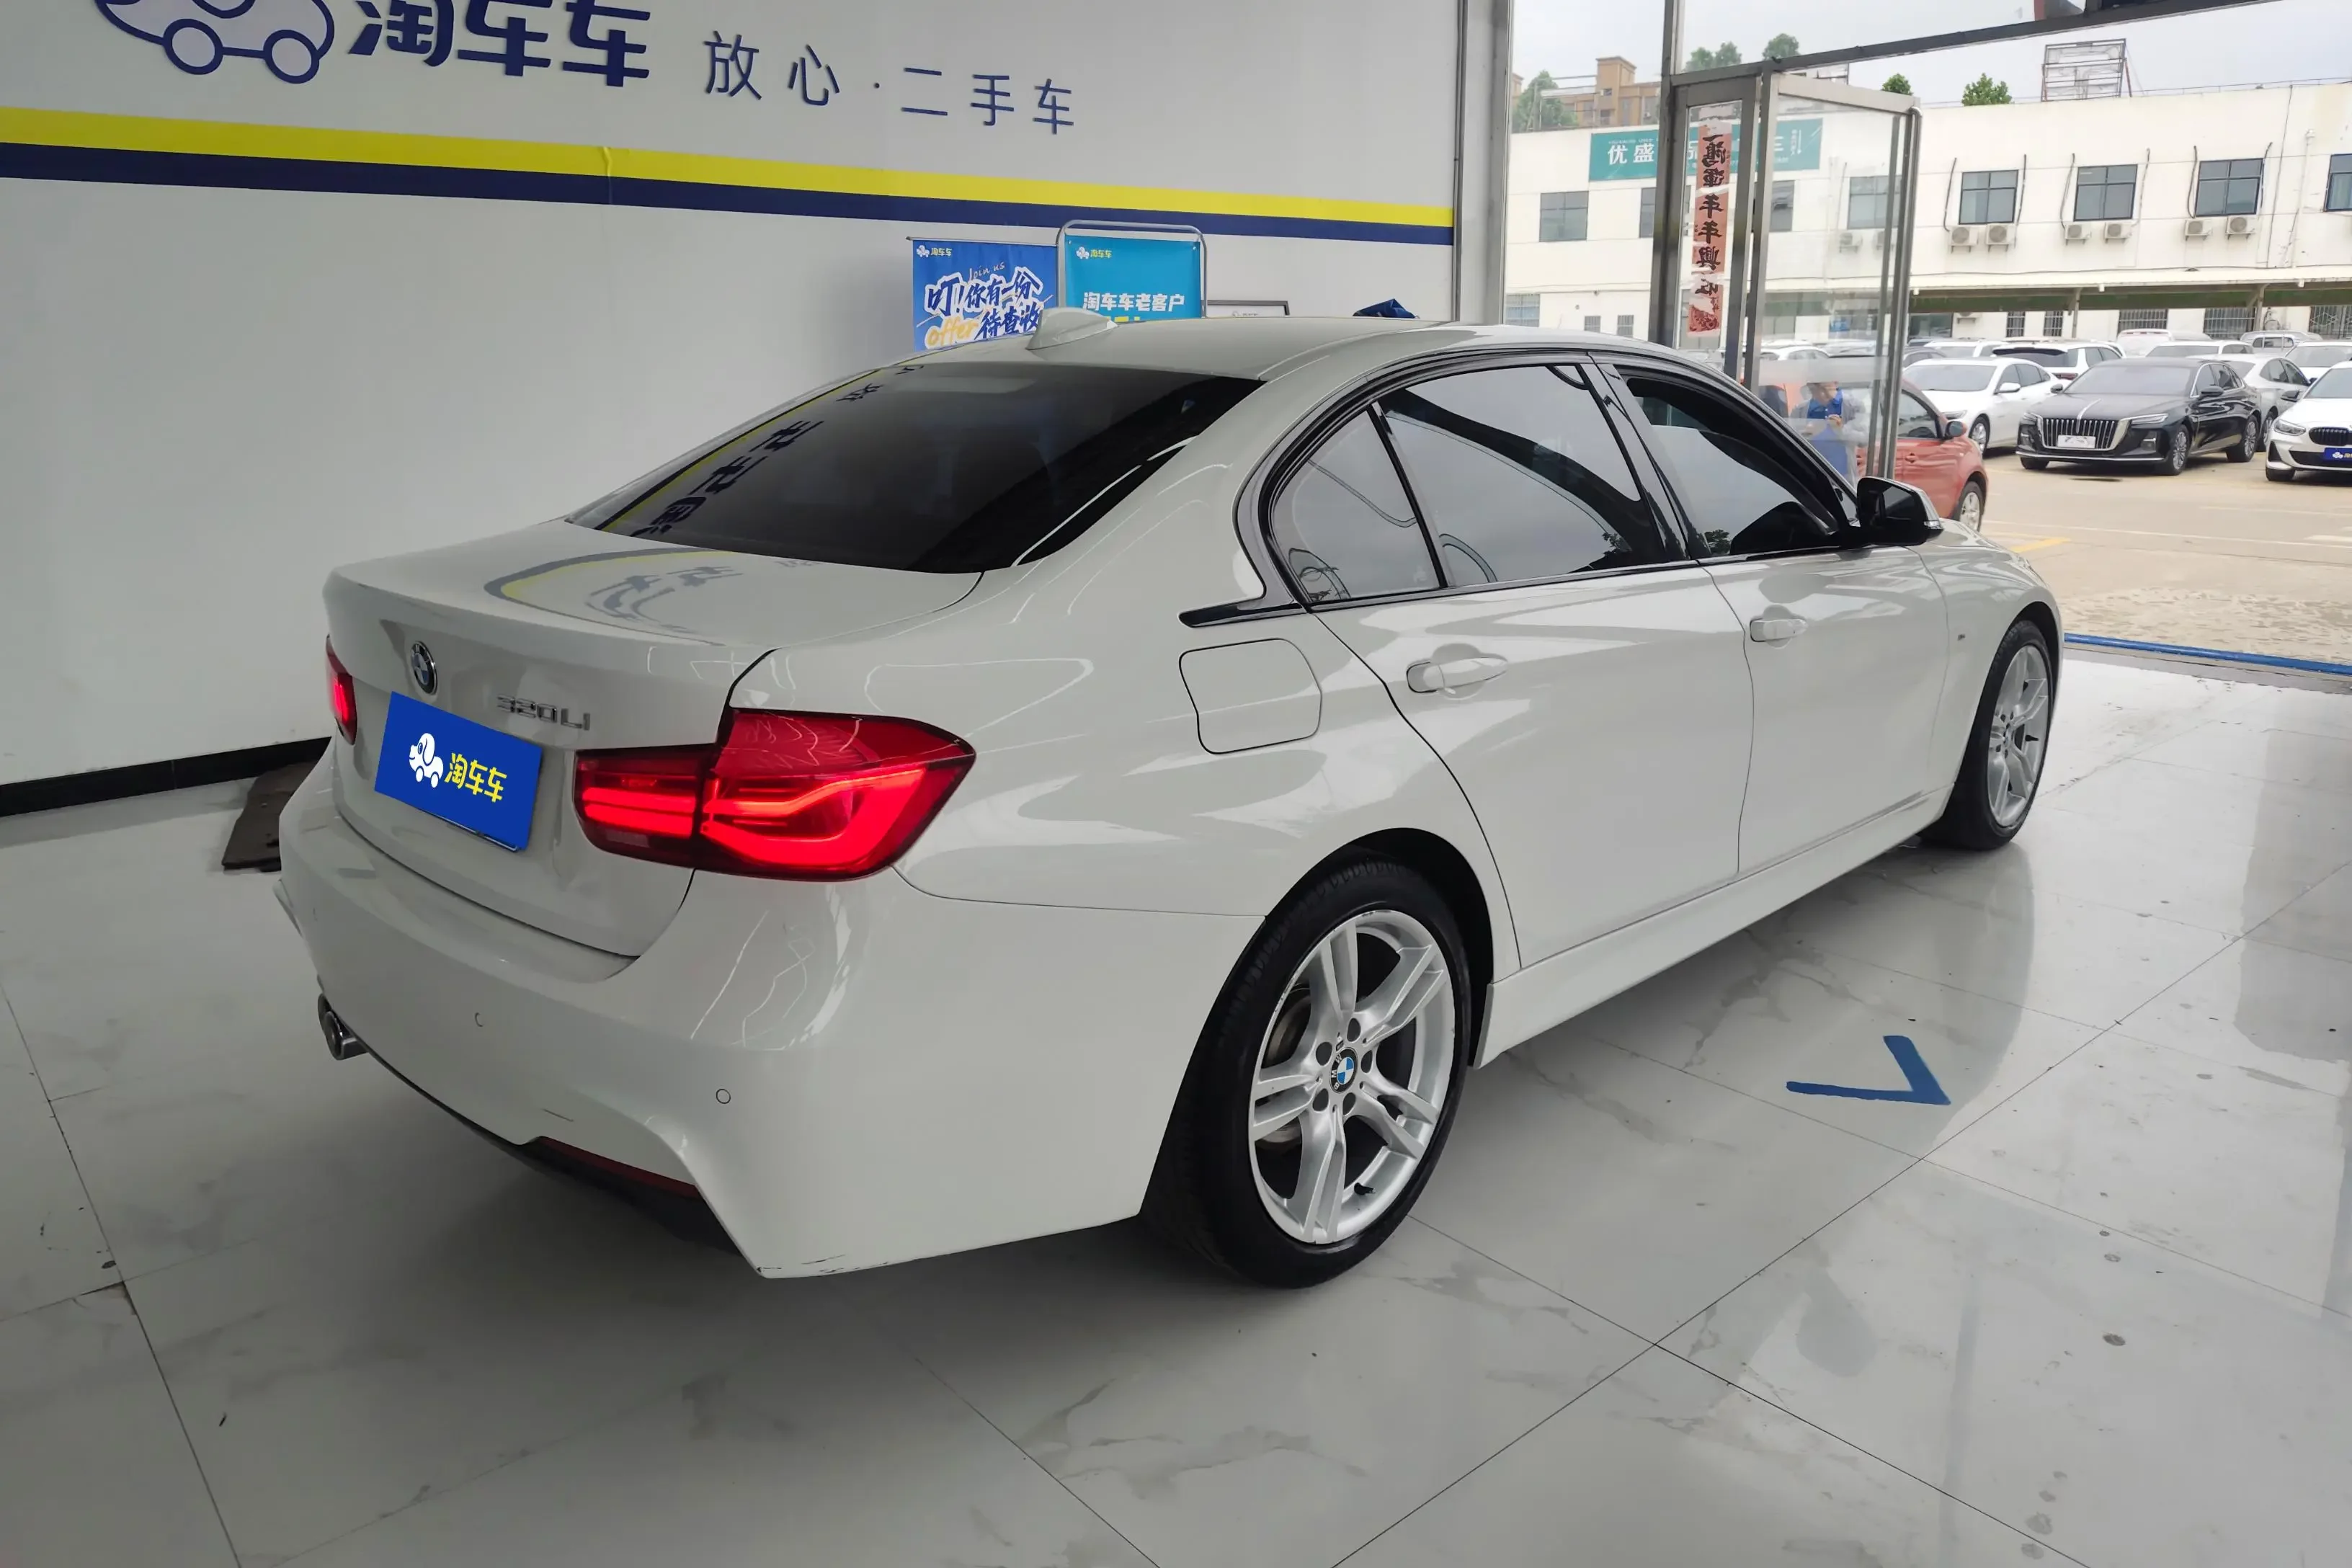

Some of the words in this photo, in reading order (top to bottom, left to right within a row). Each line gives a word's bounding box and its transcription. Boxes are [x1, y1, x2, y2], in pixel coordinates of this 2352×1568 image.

[348, 0, 650, 87] 淘车车
[993, 262, 1007, 272] us
[1082, 291, 1185, 312] 淘车车老客户
[927, 316, 979, 347] offer
[974, 301, 1043, 341] 待查收
